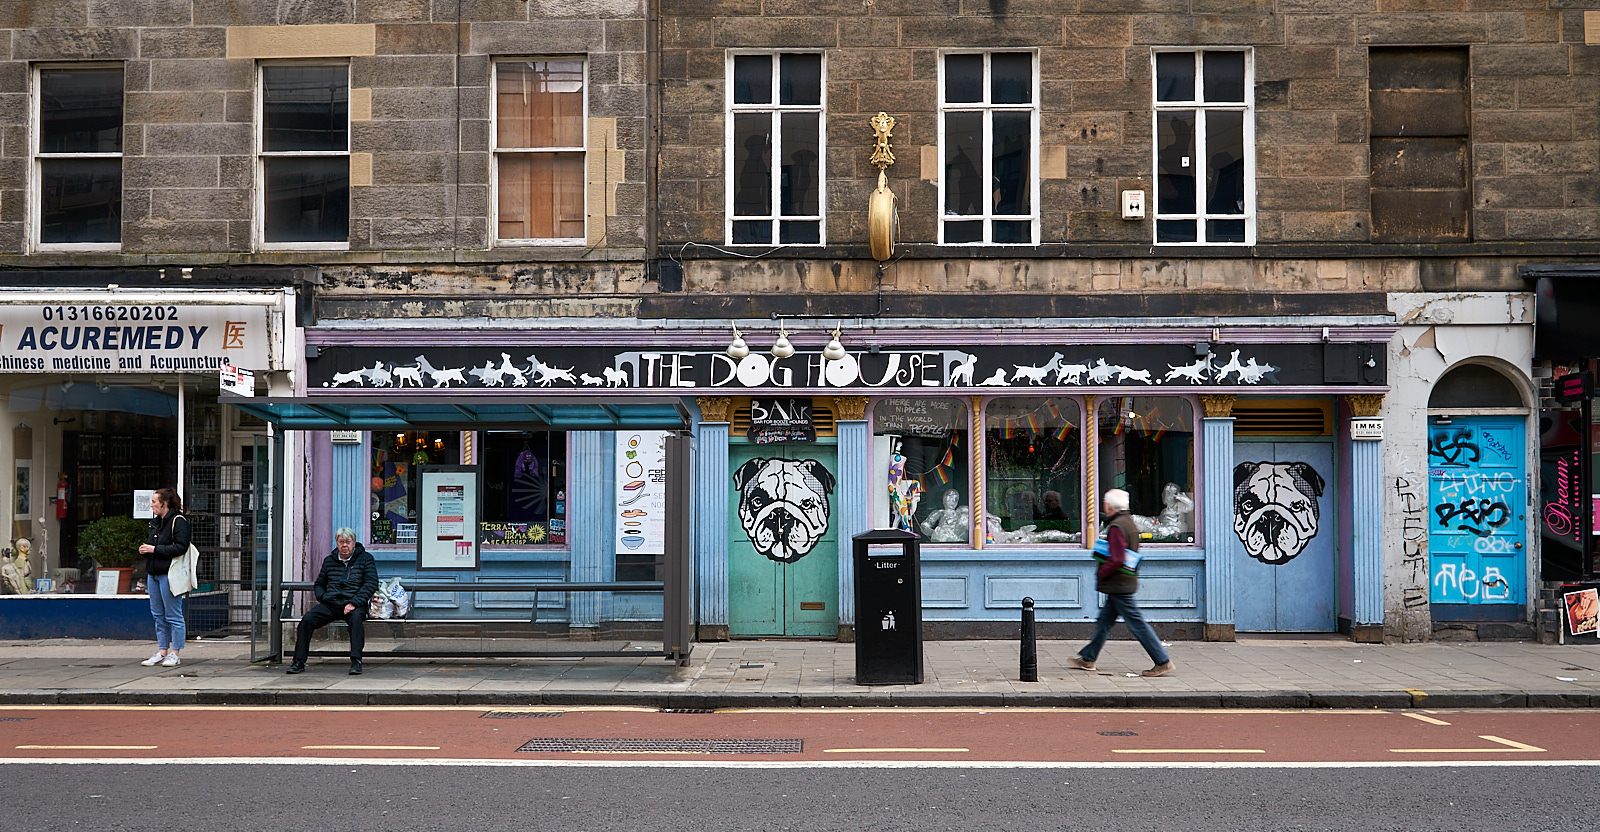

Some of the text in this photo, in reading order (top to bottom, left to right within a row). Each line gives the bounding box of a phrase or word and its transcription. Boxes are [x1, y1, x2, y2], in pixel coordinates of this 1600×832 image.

[43, 306, 178, 321] 01316620202
[18, 326, 208, 350] ACUREMEDY
[222, 321, 247, 350] 医
[0, 355, 44, 370] hinese
[52, 355, 111, 370] medicine
[119, 355, 141, 370] and
[150, 355, 230, 372] Acupuncture
[642, 353, 940, 388] THE DOG HOUSE
[752, 399, 812, 421] BARK
[885, 399, 950, 410] THERE ARE MORE
[896, 406, 927, 414] NIPPLES
[909, 424, 949, 436] PEOPLE!
[1544, 456, 1572, 536] Dream
[480, 522, 507, 531] TERRA
